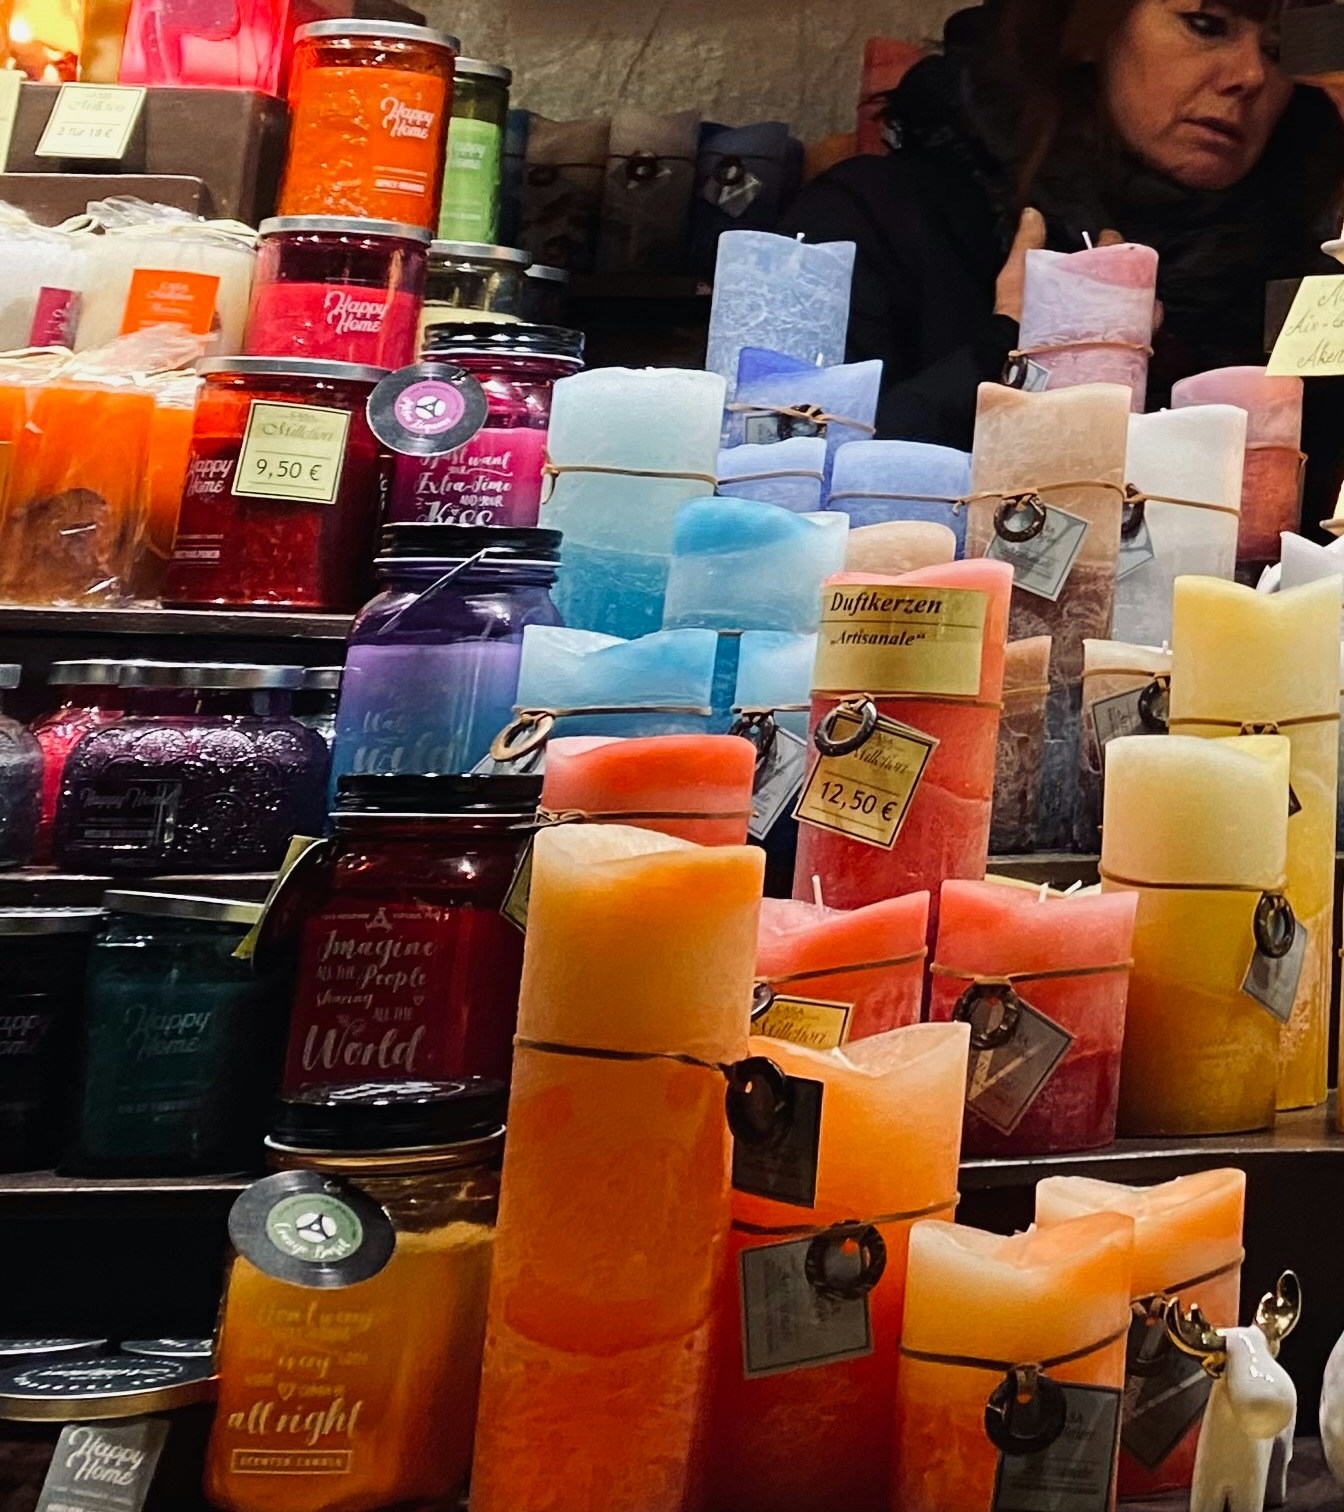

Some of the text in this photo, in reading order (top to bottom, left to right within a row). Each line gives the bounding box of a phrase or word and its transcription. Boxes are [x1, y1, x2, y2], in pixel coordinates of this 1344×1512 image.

[380, 96, 435, 127] Happy
[382, 114, 429, 139] Home
[323, 290, 388, 320] Happy
[326, 309, 382, 335] Home
[256, 458, 323, 481] 9,50 €
[468, 451, 513, 470] want
[830, 591, 943, 616] Duftkerzen
[820, 781, 898, 822] 12,50 €
[320, 929, 435, 969] Imagine
[356, 964, 427, 993] People
[124, 1004, 213, 1035] Happy
[126, 1033, 200, 1061] Home
[302, 1024, 427, 1073] World
[227, 1396, 365, 1447] all right
[67, 1425, 146, 1470] Happy
[65, 1449, 135, 1486] Home
